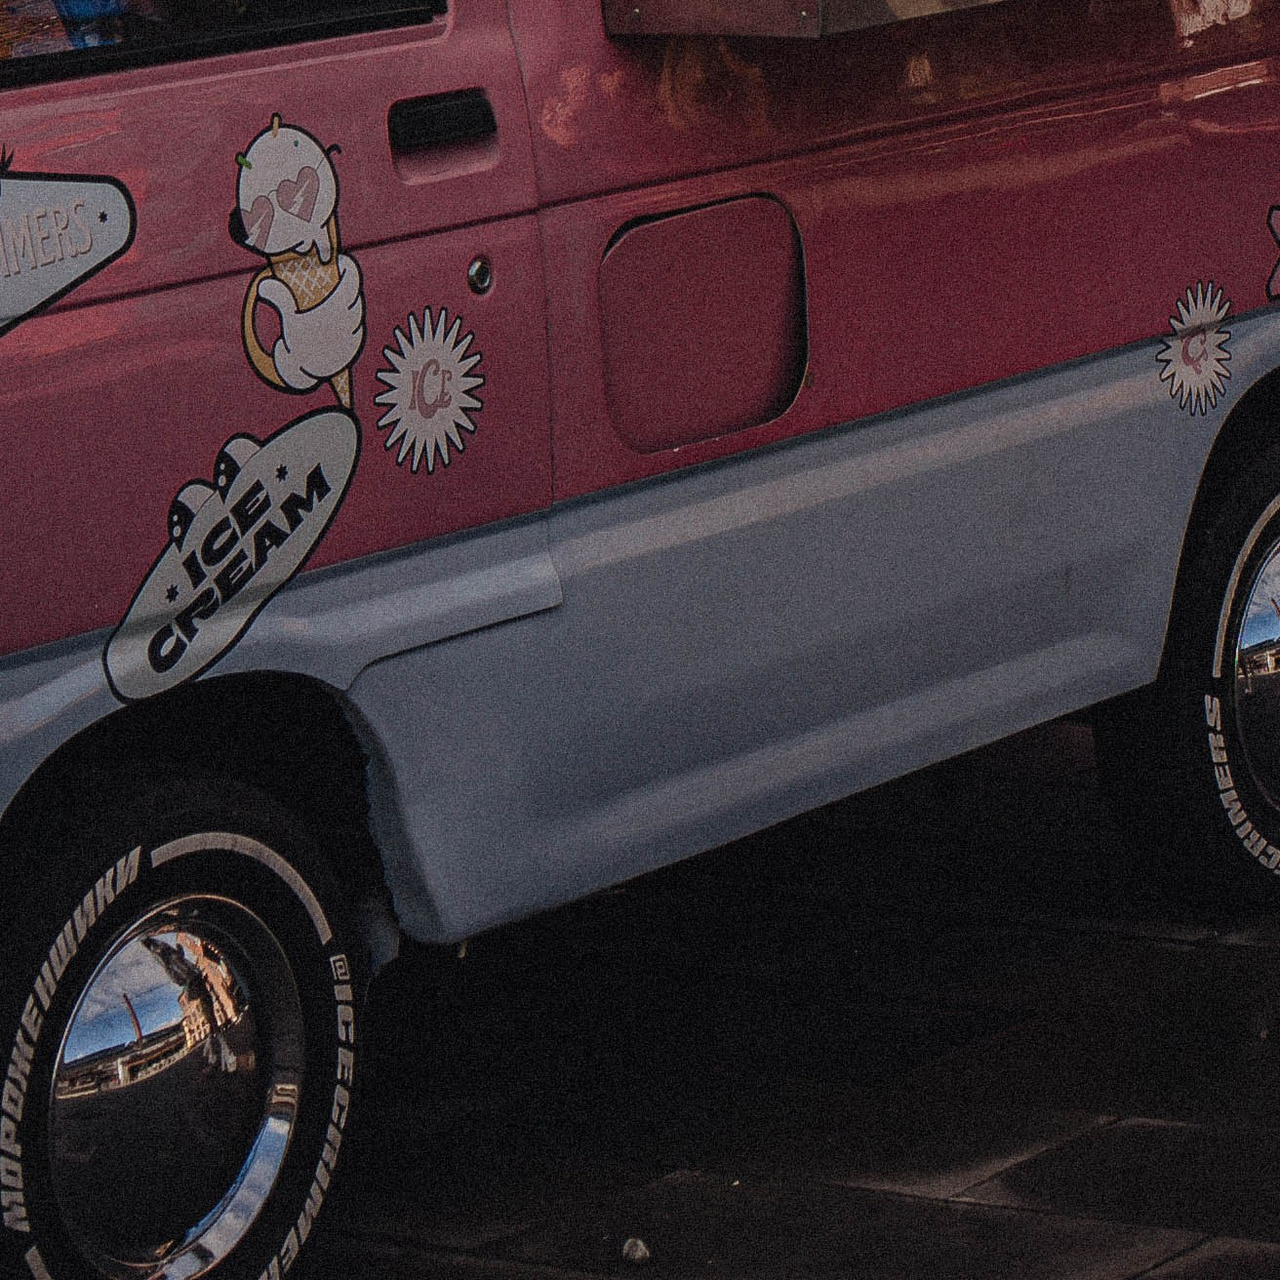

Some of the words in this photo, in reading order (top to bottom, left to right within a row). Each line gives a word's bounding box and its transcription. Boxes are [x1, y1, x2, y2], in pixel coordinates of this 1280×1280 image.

[409, 359, 453, 420] ICE
[148, 462, 331, 676] CREAM
[180, 480, 272, 590] ICE
[0, 845, 143, 1233] МОРОЖЕНЩИКИ
